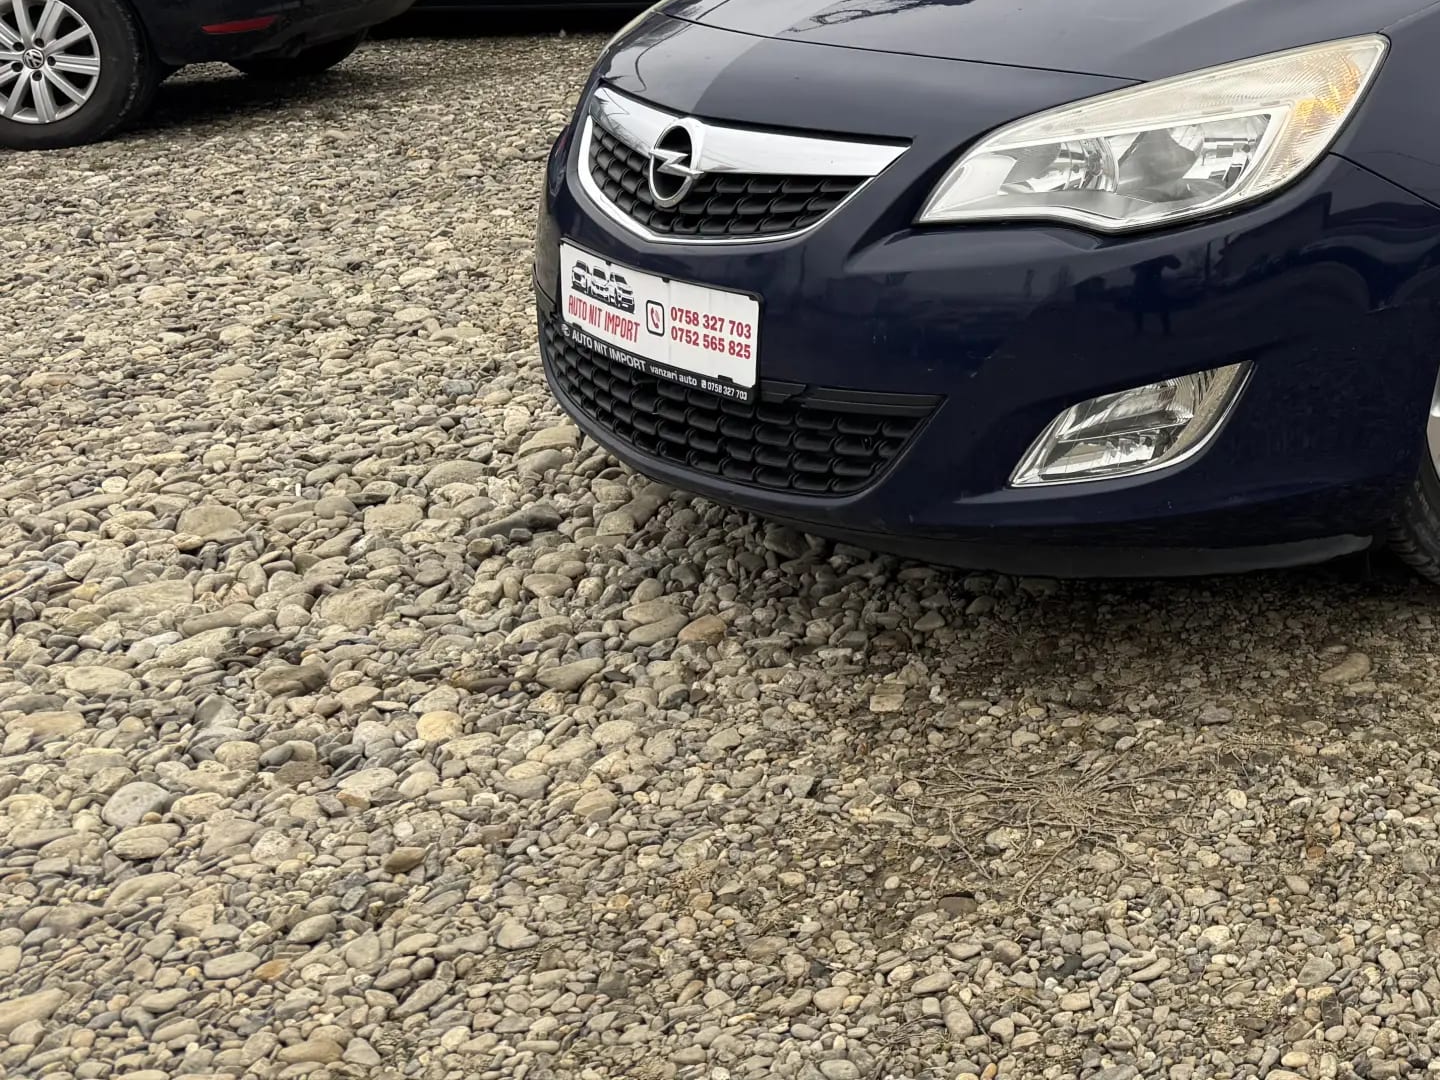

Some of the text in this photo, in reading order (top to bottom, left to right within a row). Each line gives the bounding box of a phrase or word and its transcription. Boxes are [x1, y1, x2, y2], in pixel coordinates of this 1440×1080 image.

[568, 295, 640, 343] AUTO NIT IMPORT
[671, 306, 751, 339] 0758 327 703
[671, 326, 751, 360] 0752 565 825
[572, 329, 748, 400] AUTO NIT IMPORT vanzari auto 0758 327 703
